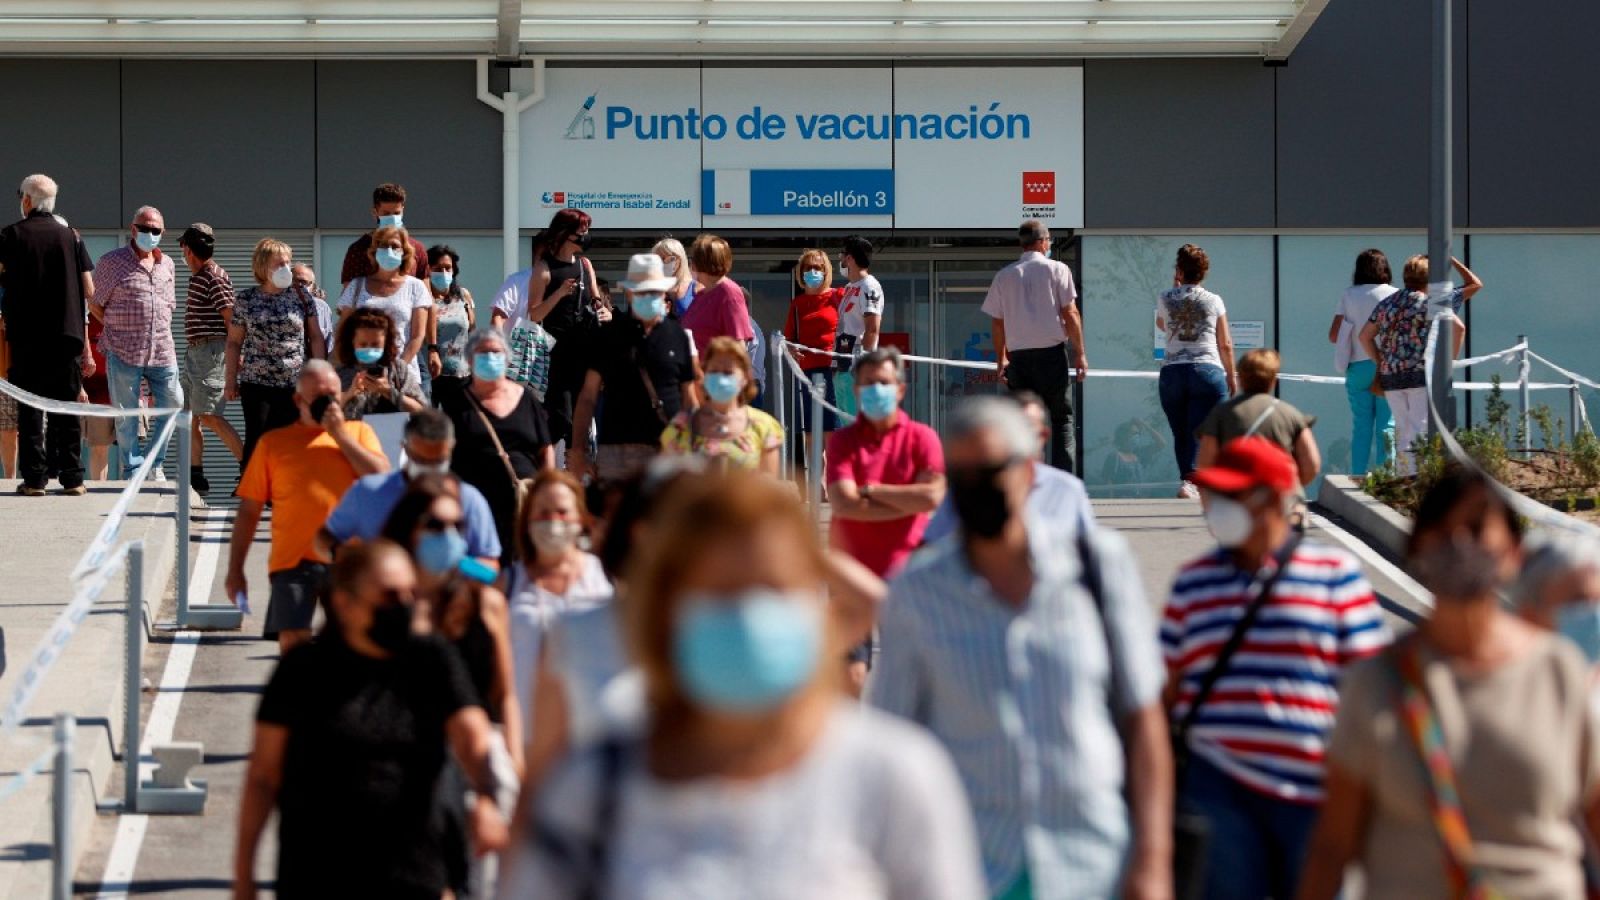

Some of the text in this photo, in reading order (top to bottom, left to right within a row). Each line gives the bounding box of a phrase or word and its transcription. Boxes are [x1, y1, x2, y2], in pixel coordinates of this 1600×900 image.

[606, 102, 1030, 140] Punto de vacunación
[567, 192, 652, 201] Hospital de Emergencias
[783, 190, 887, 208] Pabellón 3
[567, 200, 620, 209] Enfermera
[623, 200, 653, 209] Isabel
[656, 200, 690, 209] Zendal
